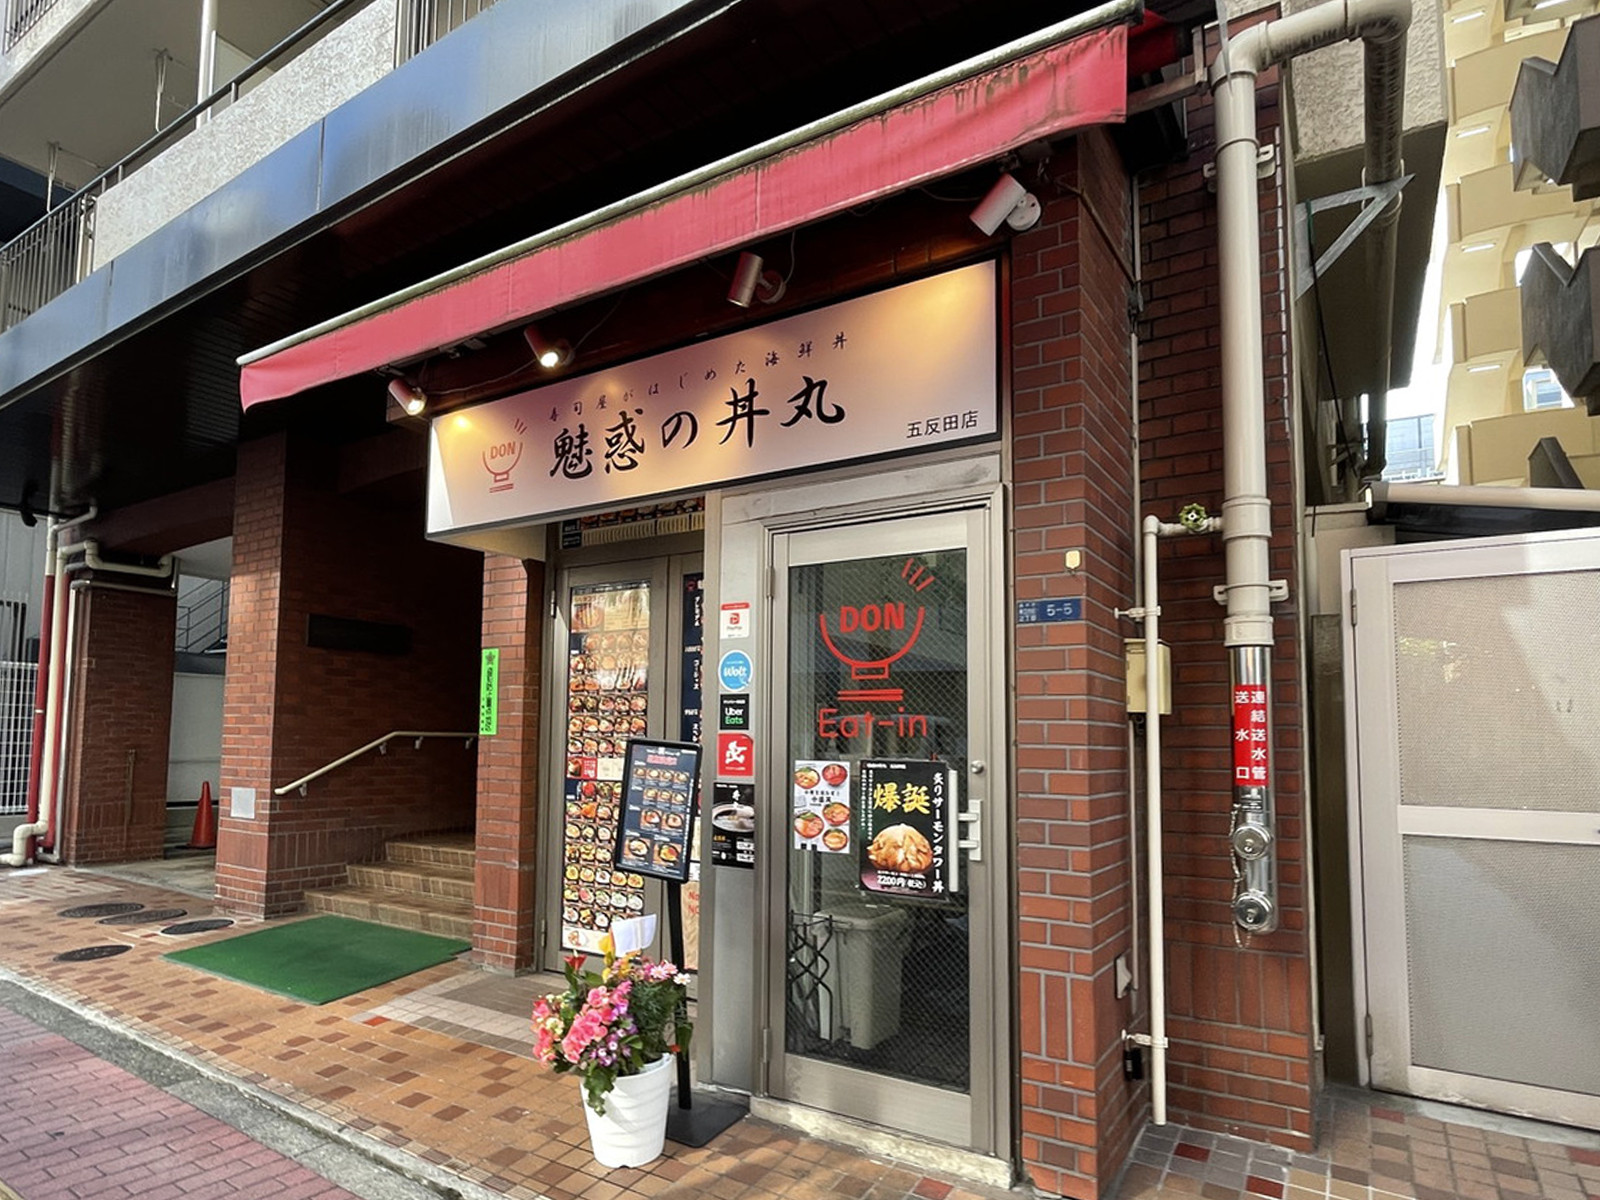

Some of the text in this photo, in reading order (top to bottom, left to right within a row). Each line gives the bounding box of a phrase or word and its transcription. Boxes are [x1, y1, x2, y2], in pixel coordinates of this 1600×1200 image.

[549, 331, 848, 422] 寿司屋がはじめた海鮮丼
[549, 375, 846, 480] 魅惑の丼丸
[906, 410, 979, 439] 五反田店
[490, 441, 516, 459] DON
[839, 602, 905, 633] DON
[1046, 602, 1073, 616] 5-5
[724, 707, 744, 716] Uber
[724, 716, 744, 725] Eats
[818, 706, 928, 738] Eat-in
[1234, 690, 1250, 780] 送水口
[1250, 690, 1267, 780] 連結送水管
[873, 781, 931, 815] 爆誕
[931, 772, 945, 893] 炙りサーモンタワー丼
